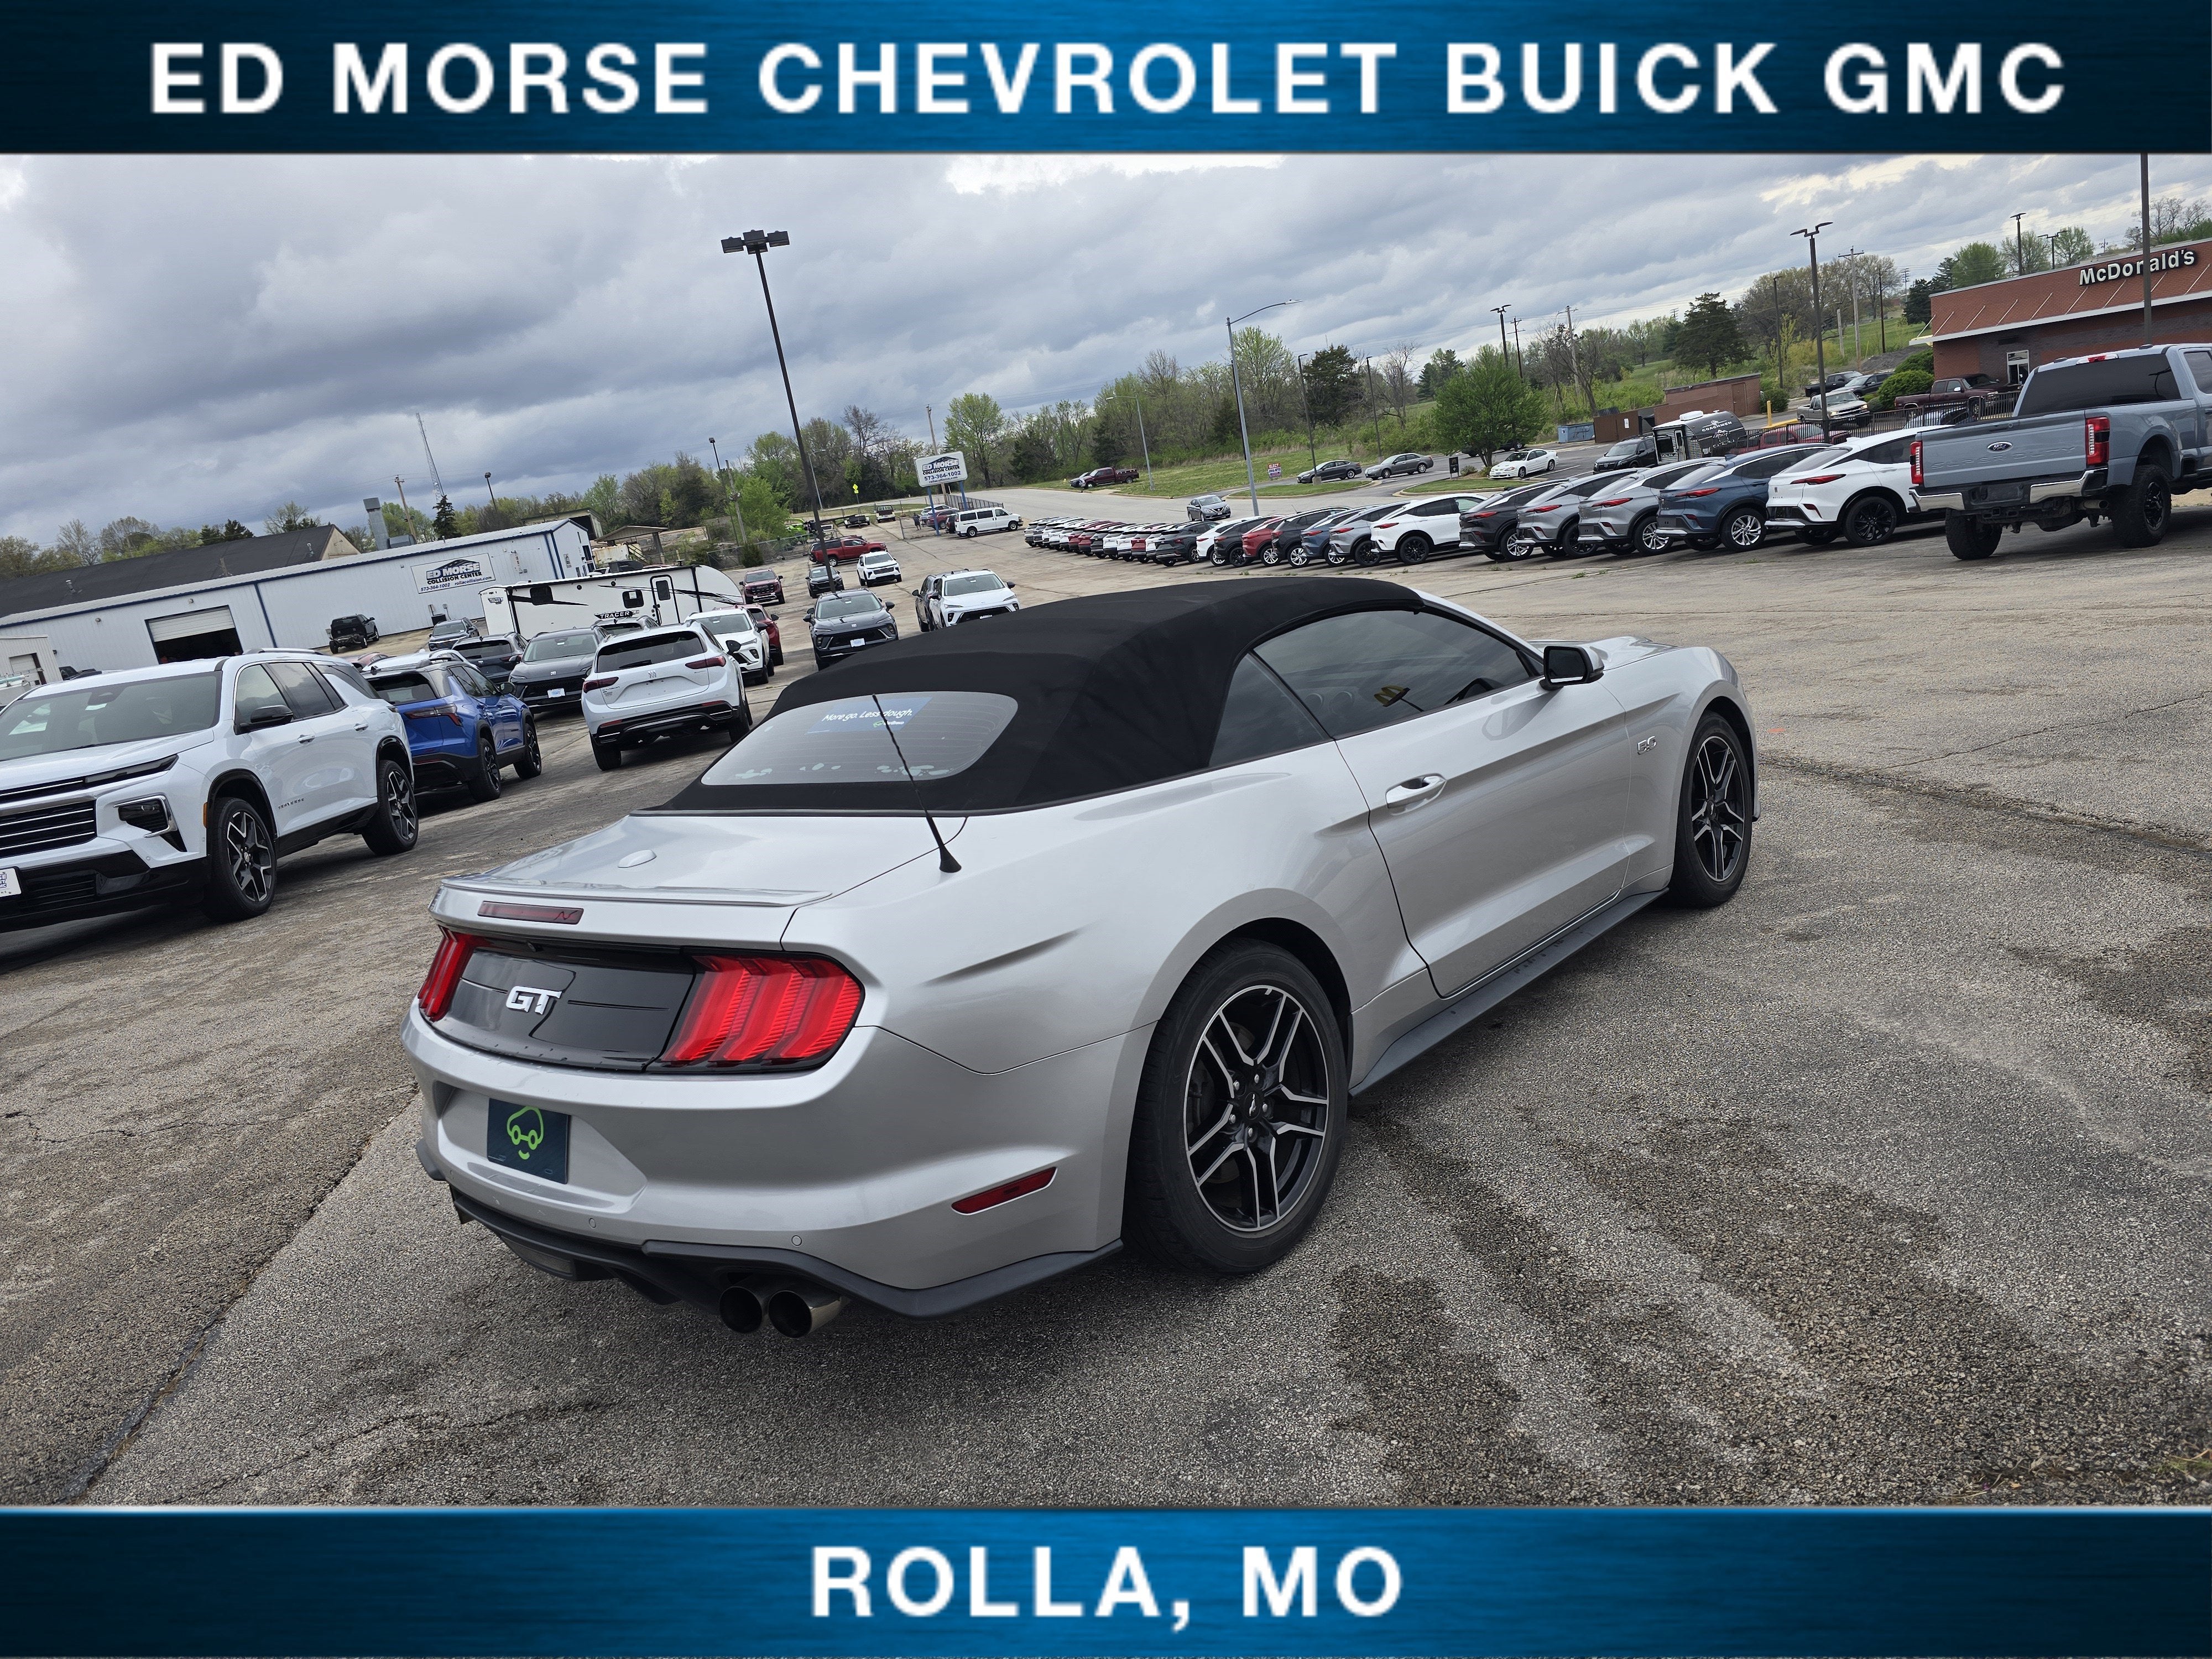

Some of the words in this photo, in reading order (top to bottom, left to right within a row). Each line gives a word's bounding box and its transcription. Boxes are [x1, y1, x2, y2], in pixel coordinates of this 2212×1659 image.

[2079, 249, 2195, 285] McDonald's
[1702, 421, 1733, 432] COACHMEN
[933, 459, 958, 469] MORSE
[1931, 455, 2007, 469] SUPER
[2012, 447, 2076, 460] DUTY
[924, 471, 961, 481] 573-364-1002
[427, 570, 441, 579] ED
[442, 562, 479, 576] MORSE
[420, 582, 451, 592] 573-364-1002
[454, 576, 492, 586] rollacollision.com
[427, 576, 459, 585] COLLISION
[505, 985, 562, 1015] GT
